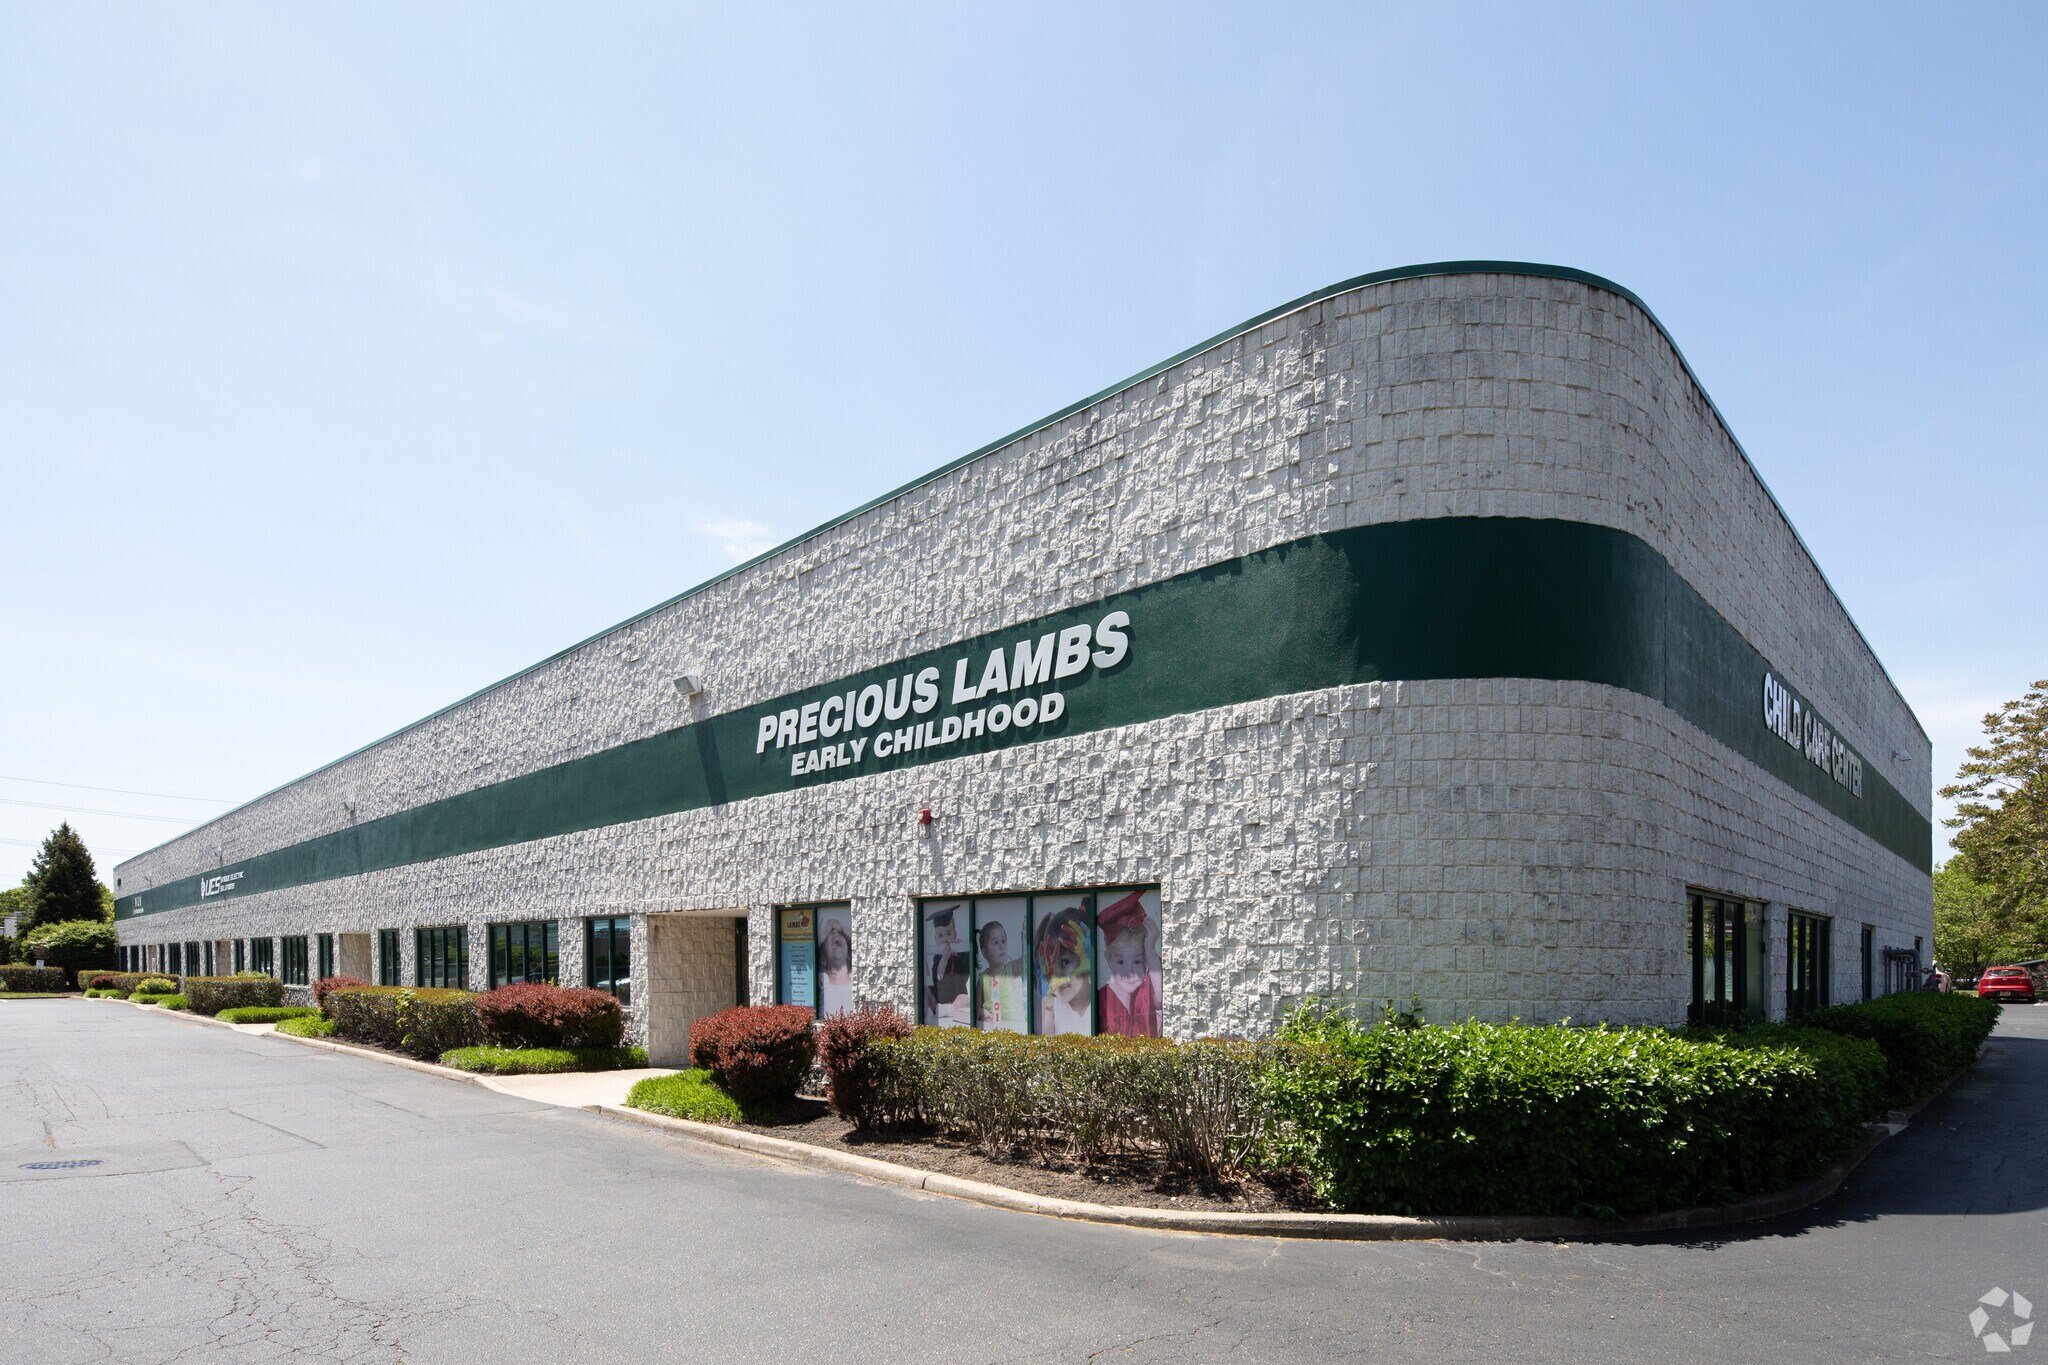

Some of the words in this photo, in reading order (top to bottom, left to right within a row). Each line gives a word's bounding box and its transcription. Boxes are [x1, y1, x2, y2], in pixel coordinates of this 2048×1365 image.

[756, 667, 939, 754] PRECIOUS
[951, 611, 1130, 705] LAMBS
[791, 736, 866, 776] EARLY
[873, 692, 1065, 758] CHILDHOOD
[1764, 672, 1801, 750] CHILD
[1804, 710, 1830, 774] CARE
[1832, 736, 1862, 799] CENTER
[205, 876, 221, 896] UES
